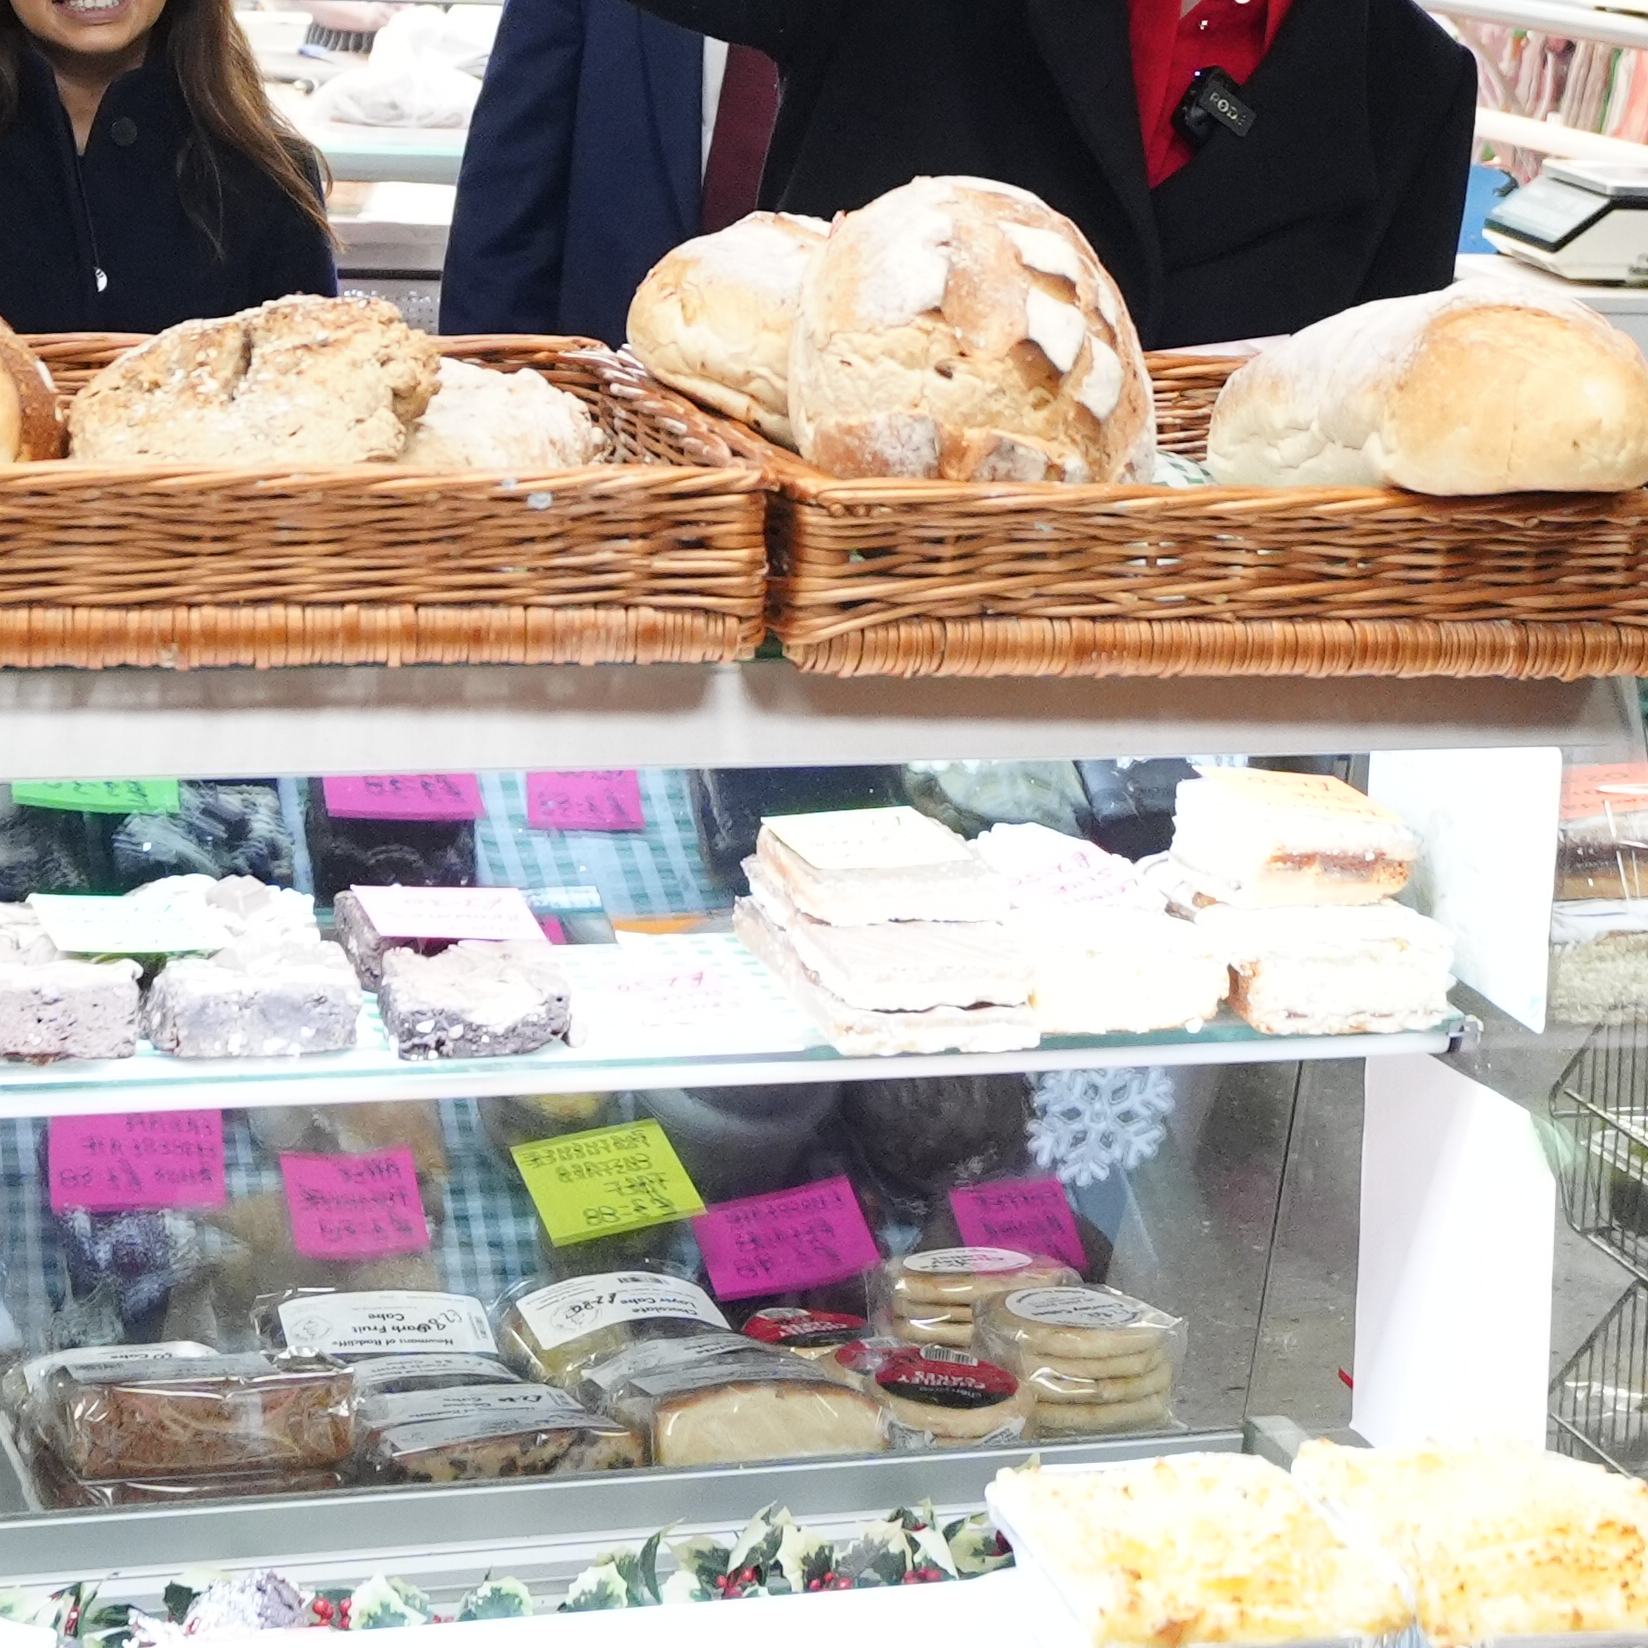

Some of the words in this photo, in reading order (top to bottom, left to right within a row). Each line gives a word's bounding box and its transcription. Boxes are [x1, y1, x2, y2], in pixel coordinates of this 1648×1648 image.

[619, 1296, 657, 1307] Cake
[658, 1296, 696, 1309] Layer
[631, 1305, 699, 1317] Chocolate
[367, 1312, 406, 1322] Cake
[351, 1323, 388, 1334] Fruit
[397, 1338, 455, 1348] Newmans
